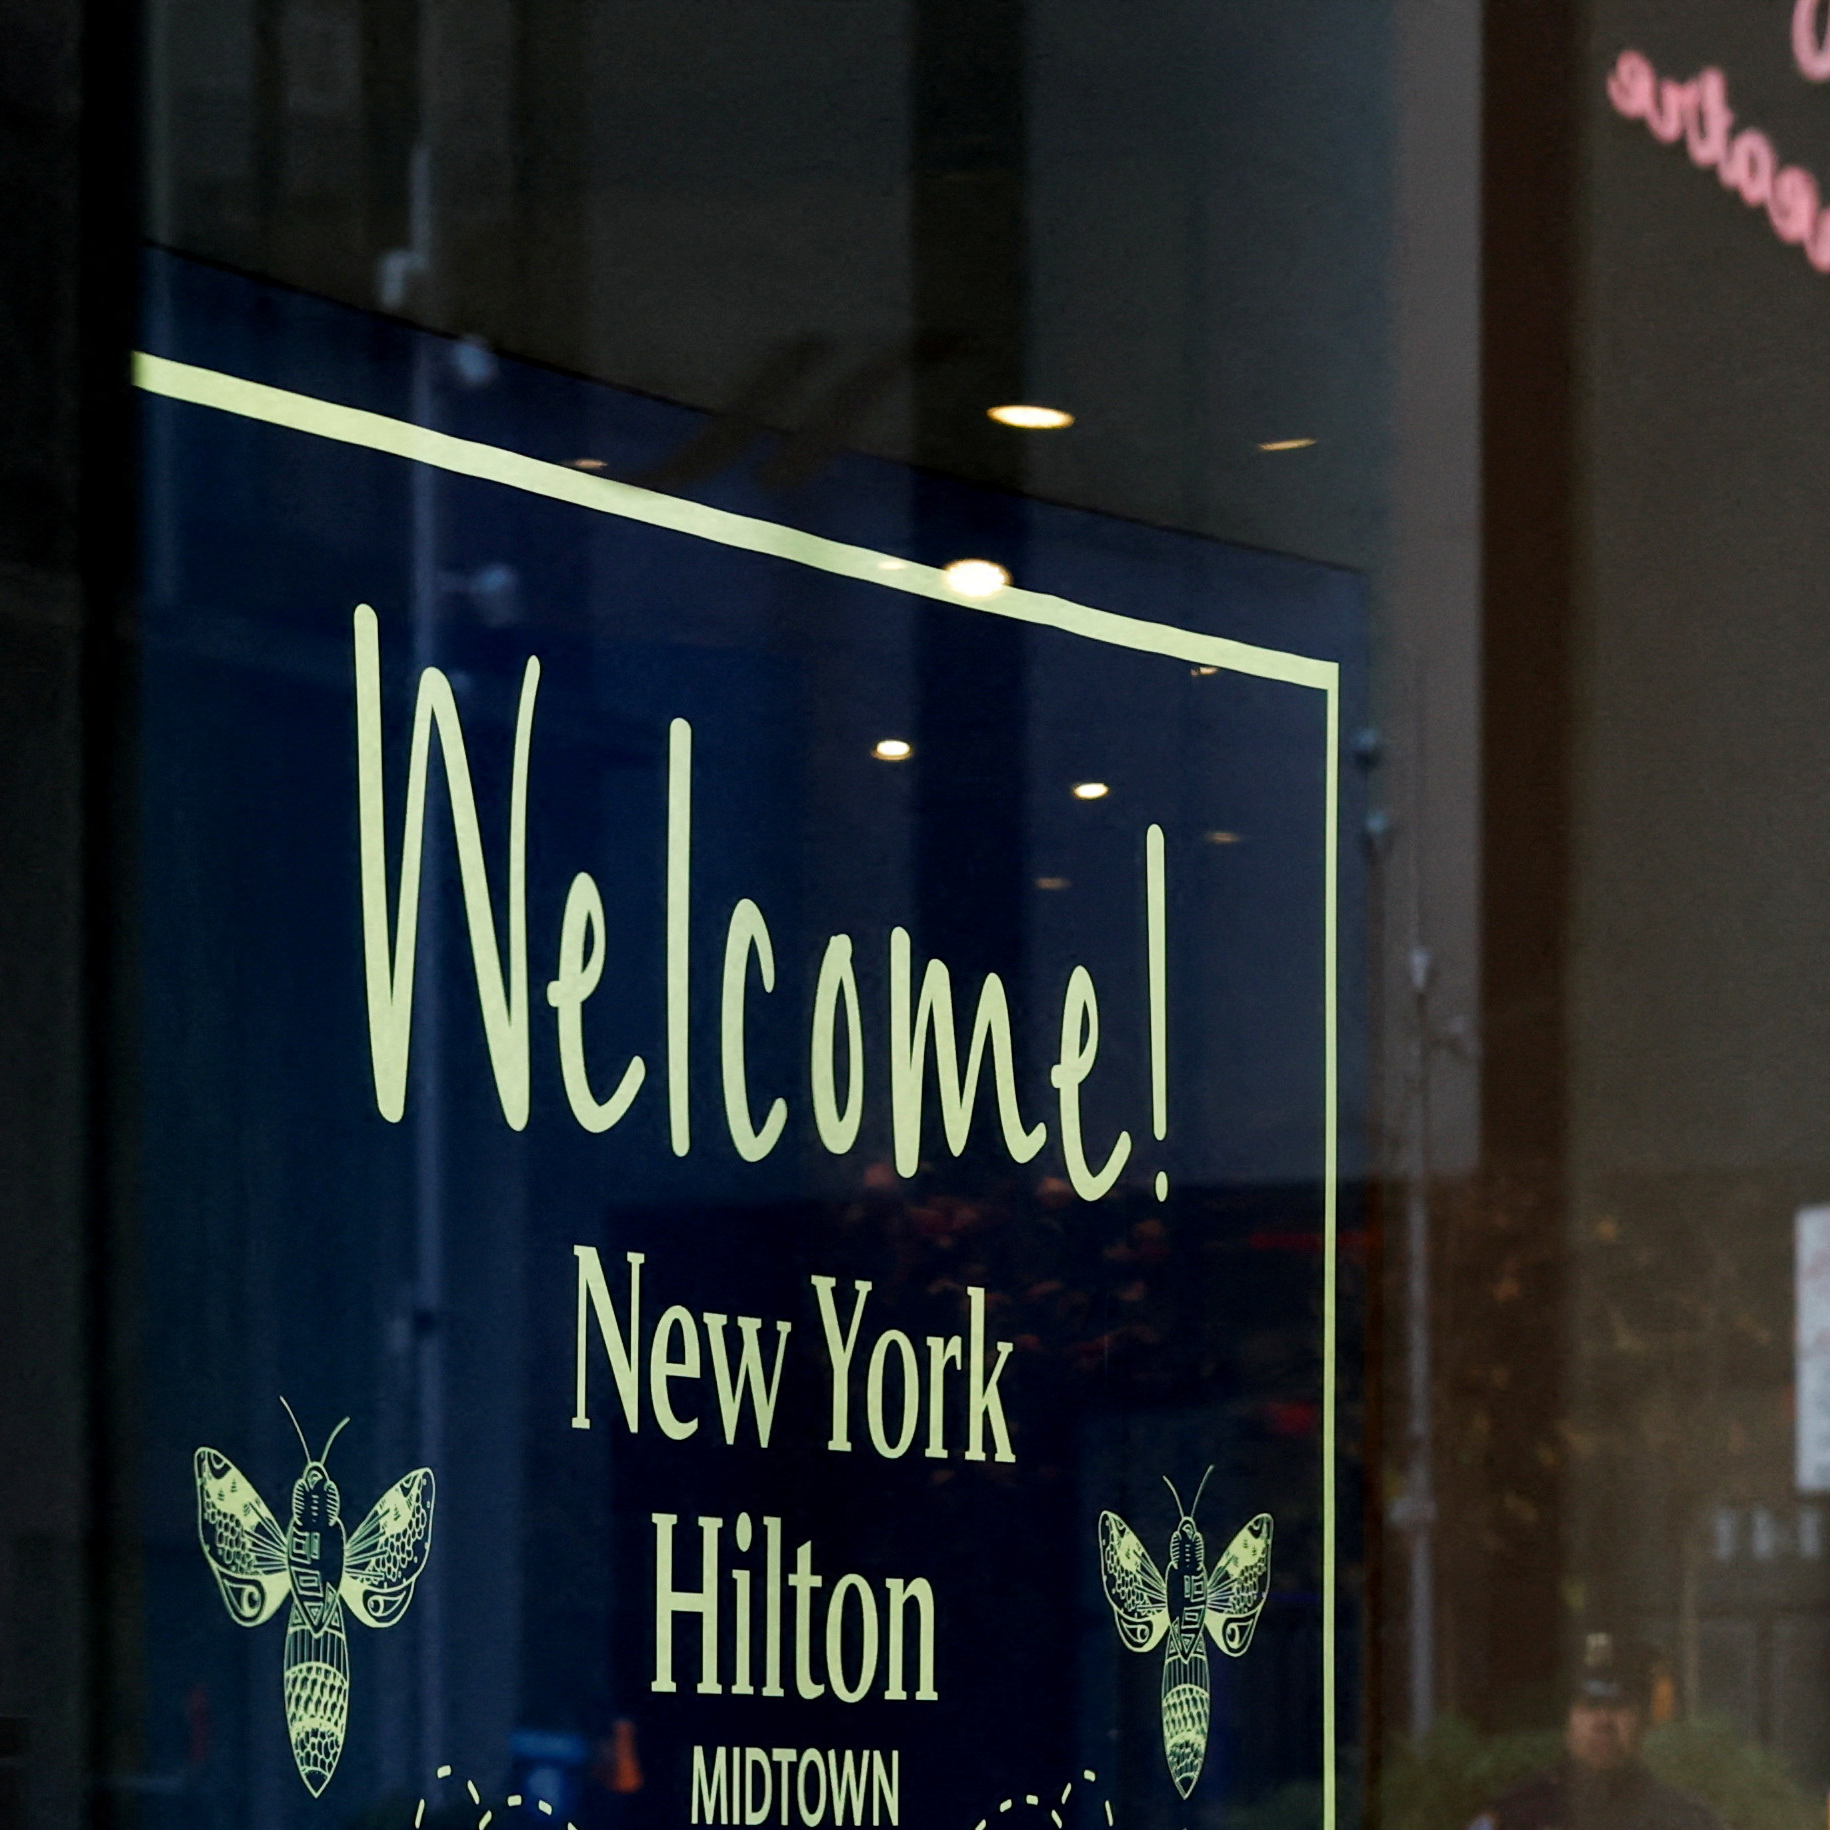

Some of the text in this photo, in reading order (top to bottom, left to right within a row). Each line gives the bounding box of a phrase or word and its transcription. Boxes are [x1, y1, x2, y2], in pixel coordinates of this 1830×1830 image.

[354, 603, 1169, 1202] Welcome!
[572, 1245, 1017, 1463] New York
[651, 1511, 939, 1703] Hilton
[691, 1746, 900, 1828] MIDTOWN
